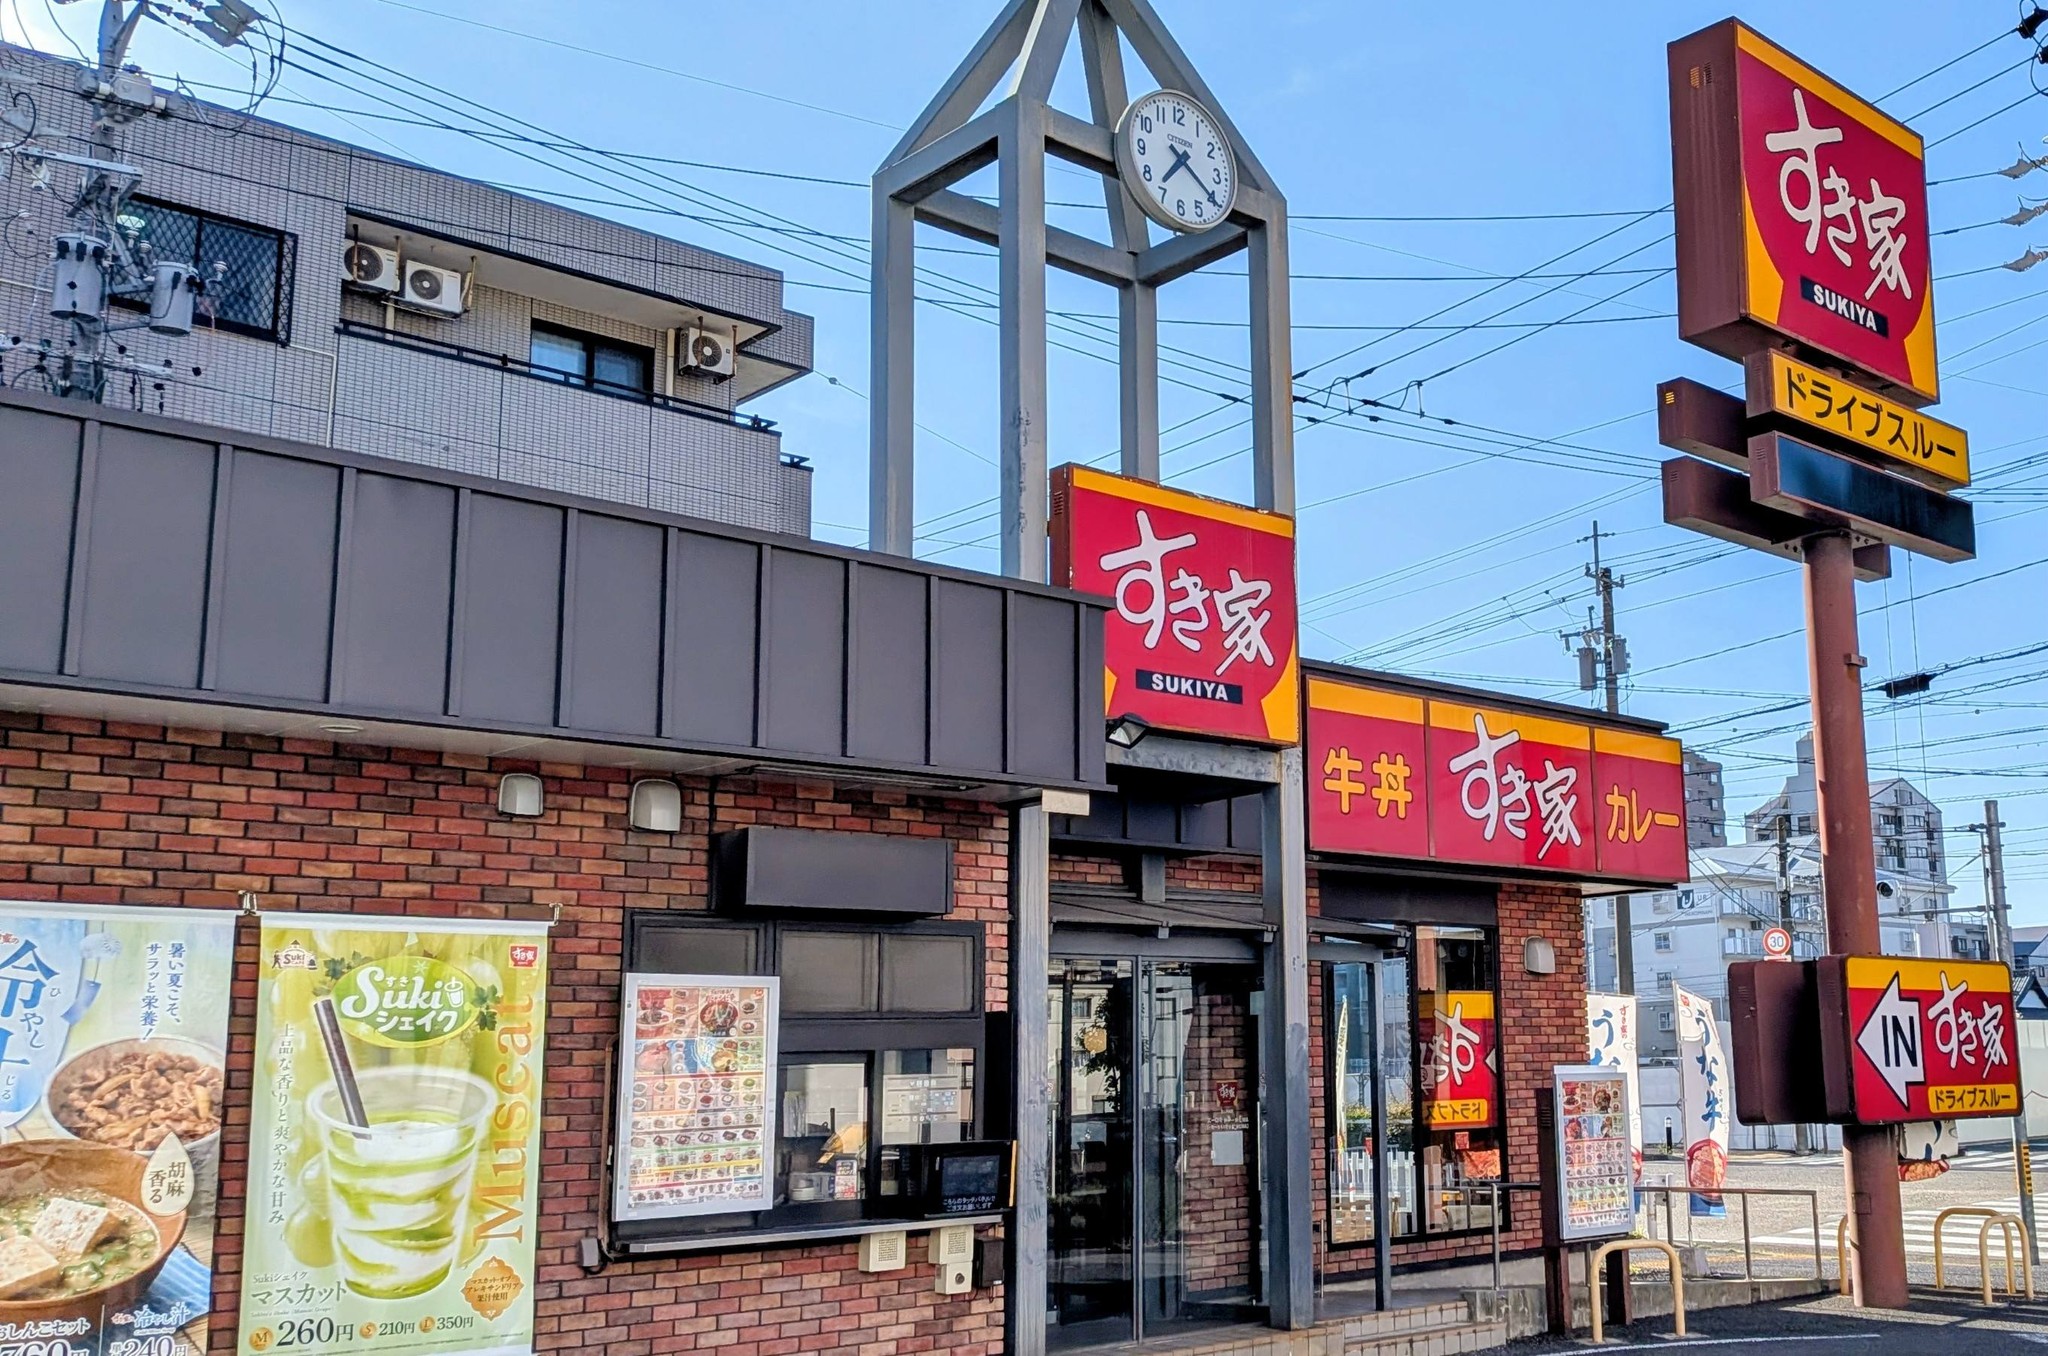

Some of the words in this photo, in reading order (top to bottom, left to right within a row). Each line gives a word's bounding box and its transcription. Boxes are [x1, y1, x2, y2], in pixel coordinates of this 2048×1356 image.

[1140, 114, 1153, 134] 10
[1173, 105, 1186, 127] 12
[1166, 133, 1193, 149] CITIZEN
[1195, 120, 1200, 138] 1
[1137, 138, 1146, 156] 9
[1207, 141, 1216, 160] 2
[1143, 164, 1153, 182] 8
[1212, 168, 1222, 185] 3
[1158, 186, 1167, 204] 7
[1765, 87, 1912, 300] すき家
[1176, 199, 1186, 217] 6
[1194, 200, 1204, 218] 5
[1813, 283, 1878, 332] SUKIYA
[1786, 366, 1957, 460] ドライブスルー
[1099, 508, 1275, 677] すき家
[1151, 672, 1229, 702] SUKIYA
[1323, 745, 1413, 820] 牛丼
[1448, 712, 1583, 860] すき家
[1605, 783, 1681, 844] カレー
[1769, 935, 1784, 948] 30
[283, 953, 306, 965] Suki
[166, 942, 186, 1023] 暑い夏こそ、
[340, 966, 444, 1019] Suki
[385, 976, 408, 988] すき
[375, 1010, 459, 1034] シェイク
[1926, 970, 2009, 1079] すき家
[1881, 1014, 1919, 1068] IN
[1934, 1087, 2012, 1110] ドライブスルー
[269, 1022, 295, 1225] 上品な香りと爽やかな甘み
[473, 993, 534, 1247] Muscat
[148, 1169, 167, 1204] 香る
[166, 1161, 187, 1197] 胡麻
[251, 1280, 347, 1306] マスカット
[275, 1316, 355, 1347] 260円
[378, 1320, 416, 1337] 210円
[436, 1315, 475, 1331] 350円
